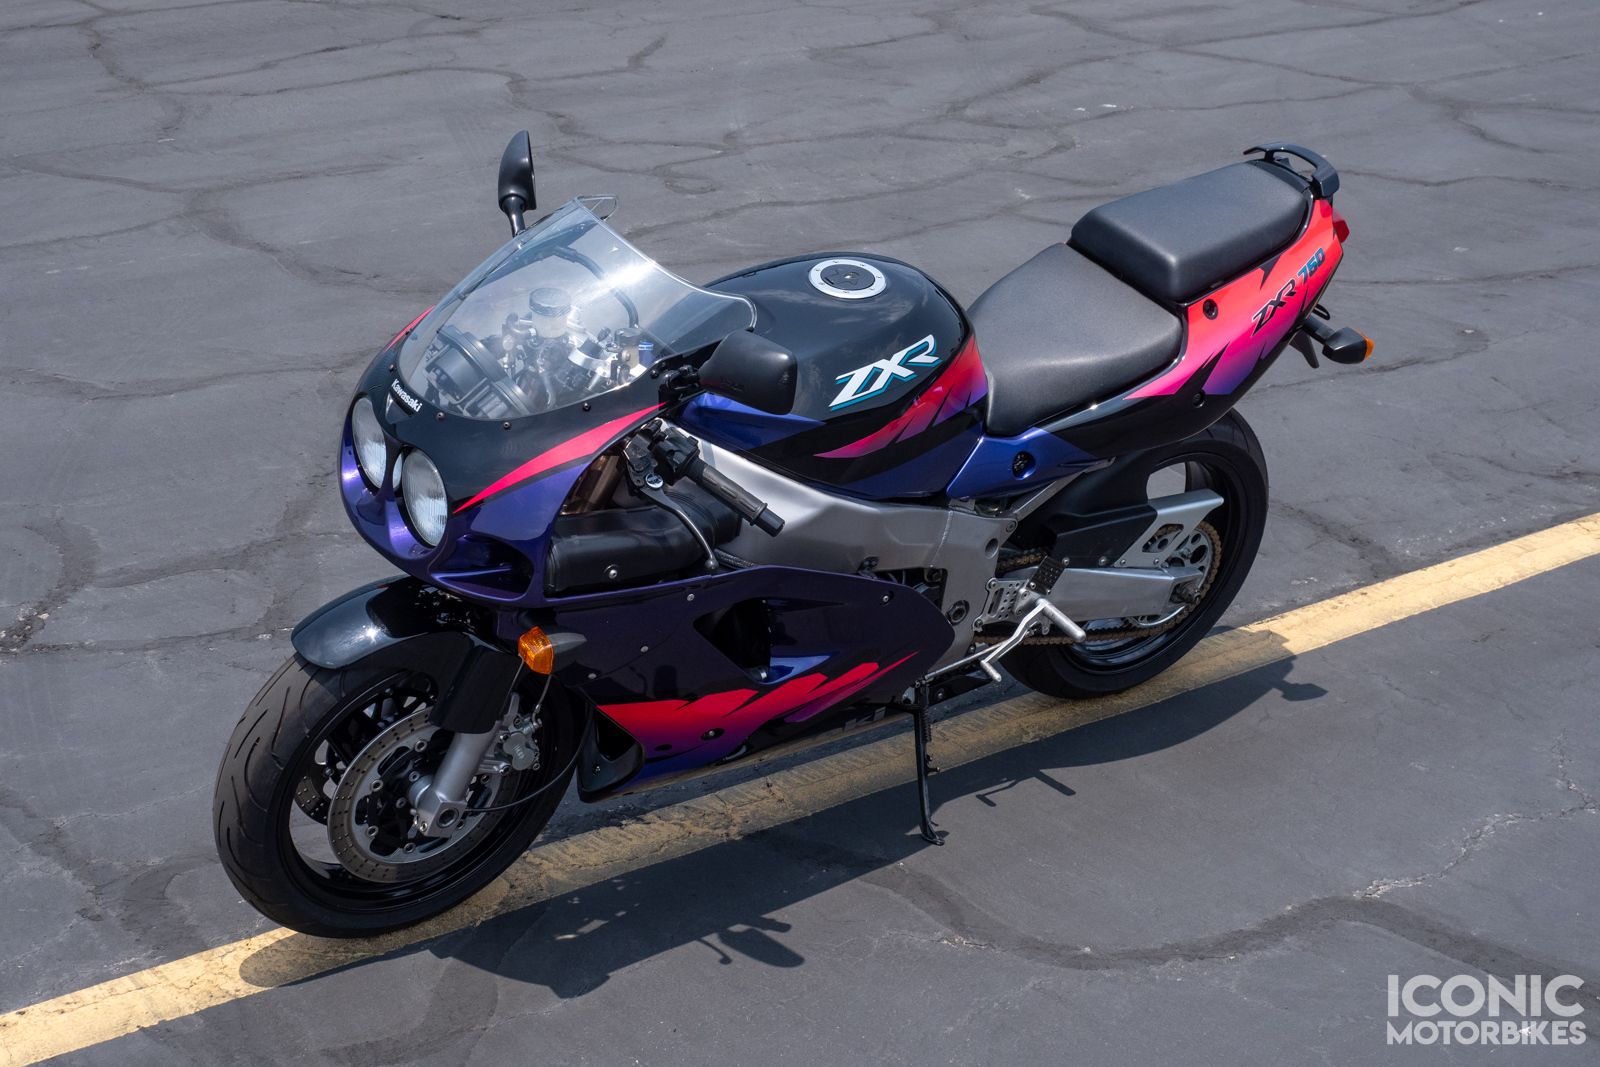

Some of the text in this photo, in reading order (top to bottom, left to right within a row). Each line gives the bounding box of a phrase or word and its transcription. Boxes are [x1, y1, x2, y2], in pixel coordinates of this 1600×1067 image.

[1252, 247, 1325, 336] ZXR 750
[391, 378, 423, 412] Kawasaki
[829, 334, 942, 411] ZXR
